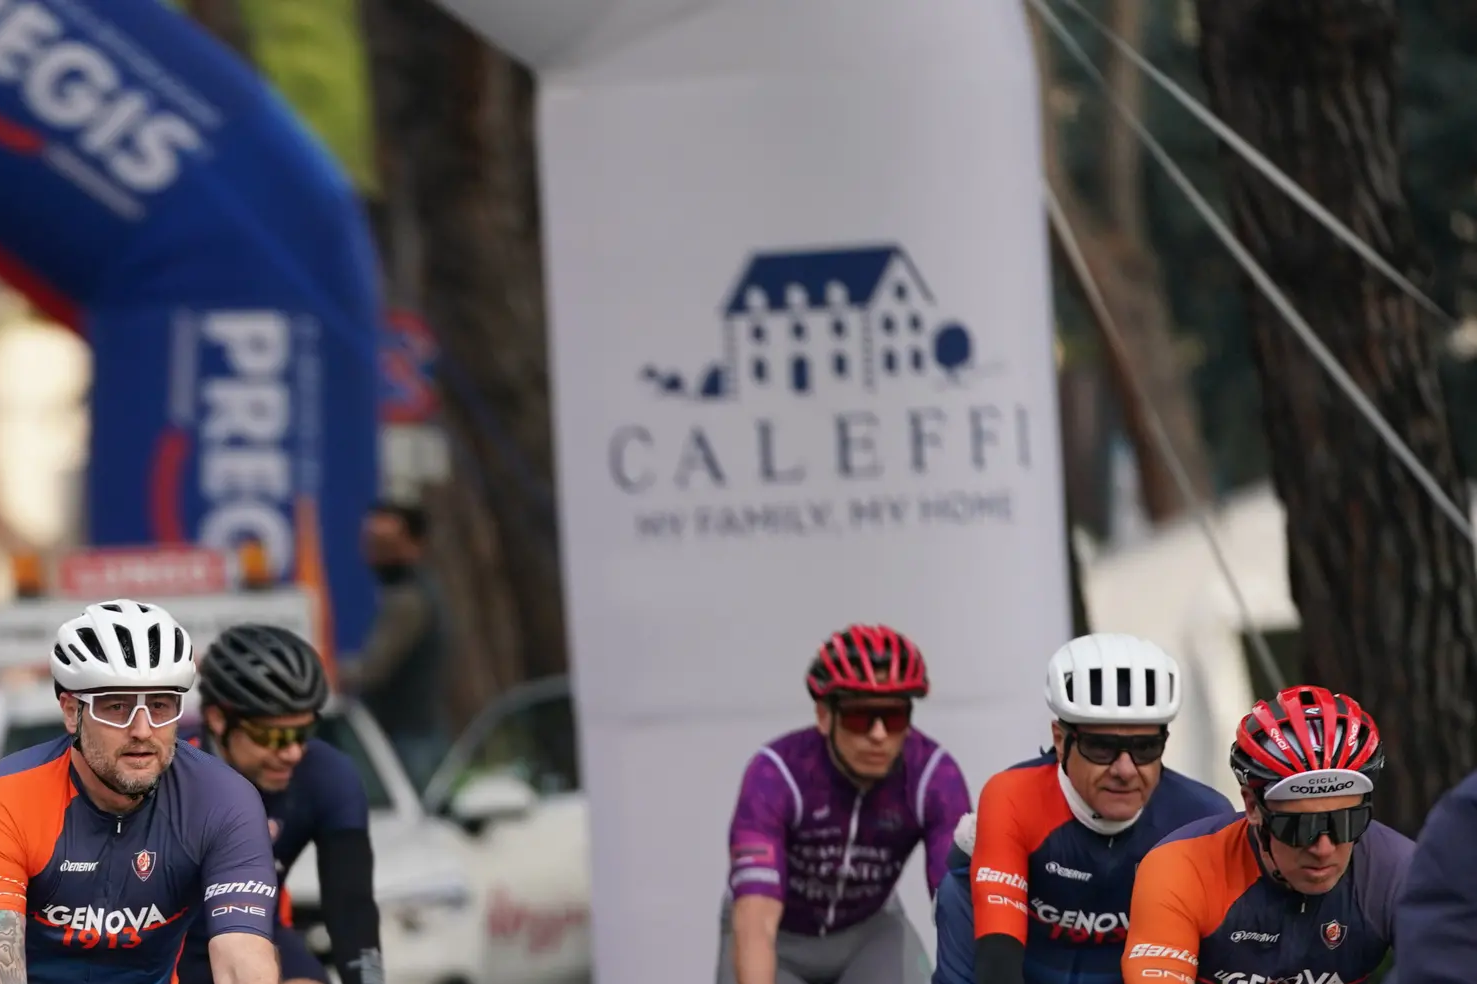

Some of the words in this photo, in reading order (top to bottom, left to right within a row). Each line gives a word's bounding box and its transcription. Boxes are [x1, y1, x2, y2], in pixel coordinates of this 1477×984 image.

[606, 402, 1032, 496] CALEFFI
[1289, 780, 1355, 795] COLNAGO
[1308, 776, 1338, 785] CICLI
[204, 880, 277, 902] Santini
[211, 905, 266, 917] ONE
